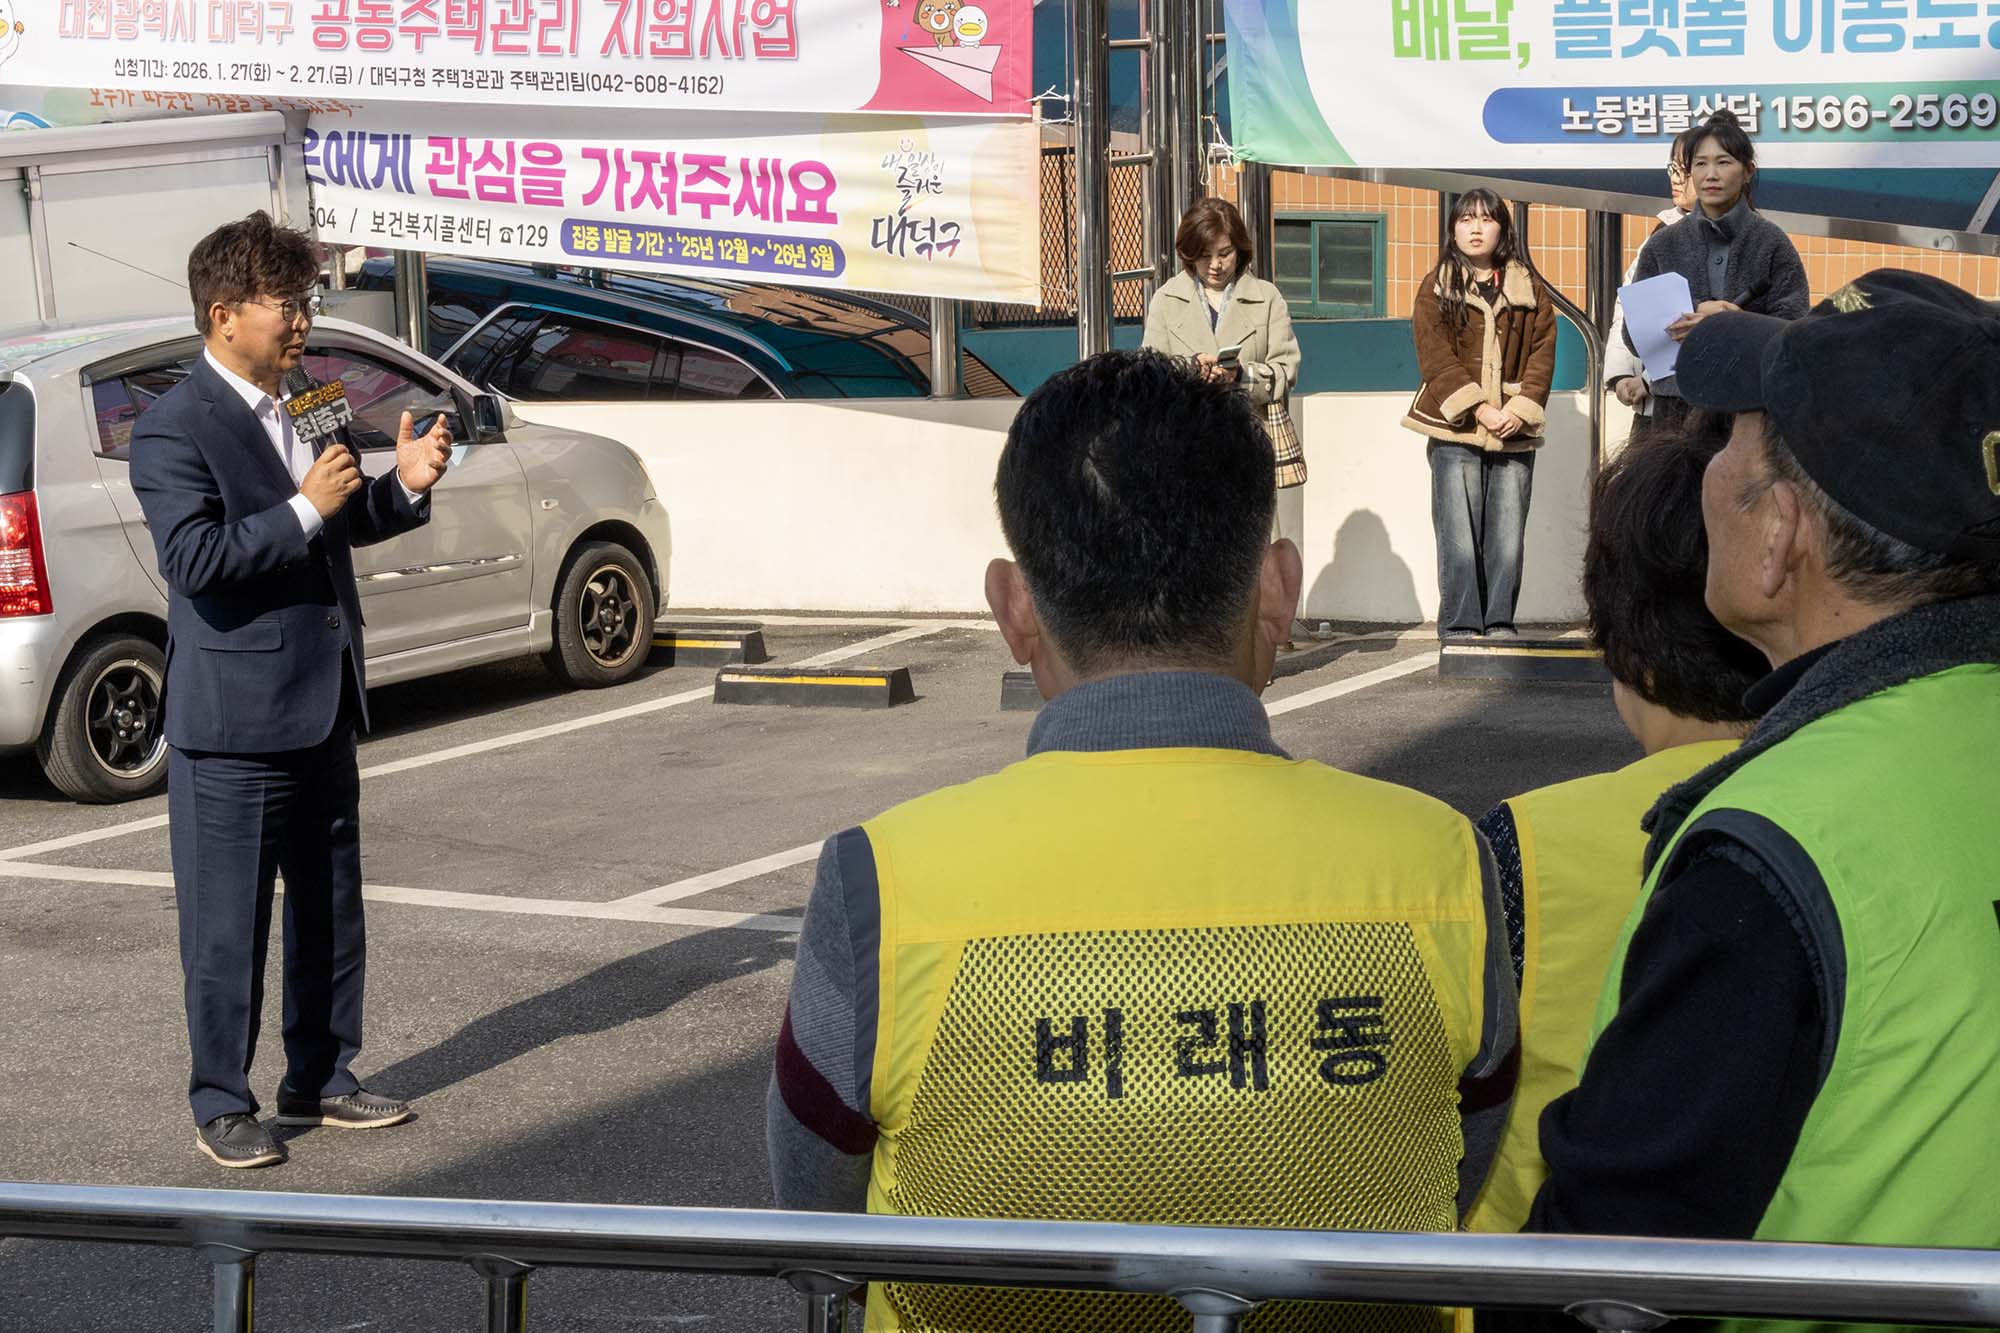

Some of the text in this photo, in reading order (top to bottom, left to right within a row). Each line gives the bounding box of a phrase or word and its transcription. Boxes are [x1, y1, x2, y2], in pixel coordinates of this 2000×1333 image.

[57, 0, 799, 59] 대전광역시 대덕구 공동주택관리 지원사업
[1391, 0, 1531, 70] 배달,
[1772, 0, 2000, 54] 이동노
[114, 58, 168, 79] 신청기간:
[172, 61, 212, 81] 2026.
[231, 62, 272, 83] 27(화)
[290, 65, 303, 84] 2.
[307, 65, 353, 86] 27.(금)
[370, 66, 427, 88] 대덕구청
[431, 68, 504, 90] 주택경관과
[510, 70, 725, 95] 주택관리팀(042-608-4162)
[1560, 92, 1997, 135] 노동법률상담 1566-2569
[425, 135, 567, 208] 관심을
[581, 147, 838, 225] 가져주세요
[896, 166, 944, 217] 즐거운
[370, 210, 491, 247] 보건복지콜센터
[571, 225, 601, 252] 집중
[603, 228, 633, 255] 발굴
[636, 231, 664, 257] 기간
[718, 238, 749, 265] 12월
[810, 245, 836, 271] 3월
[871, 214, 961, 262] 대덕구
[286, 379, 345, 417] 대덕구청장
[1035, 995, 1393, 1101] 비래동
